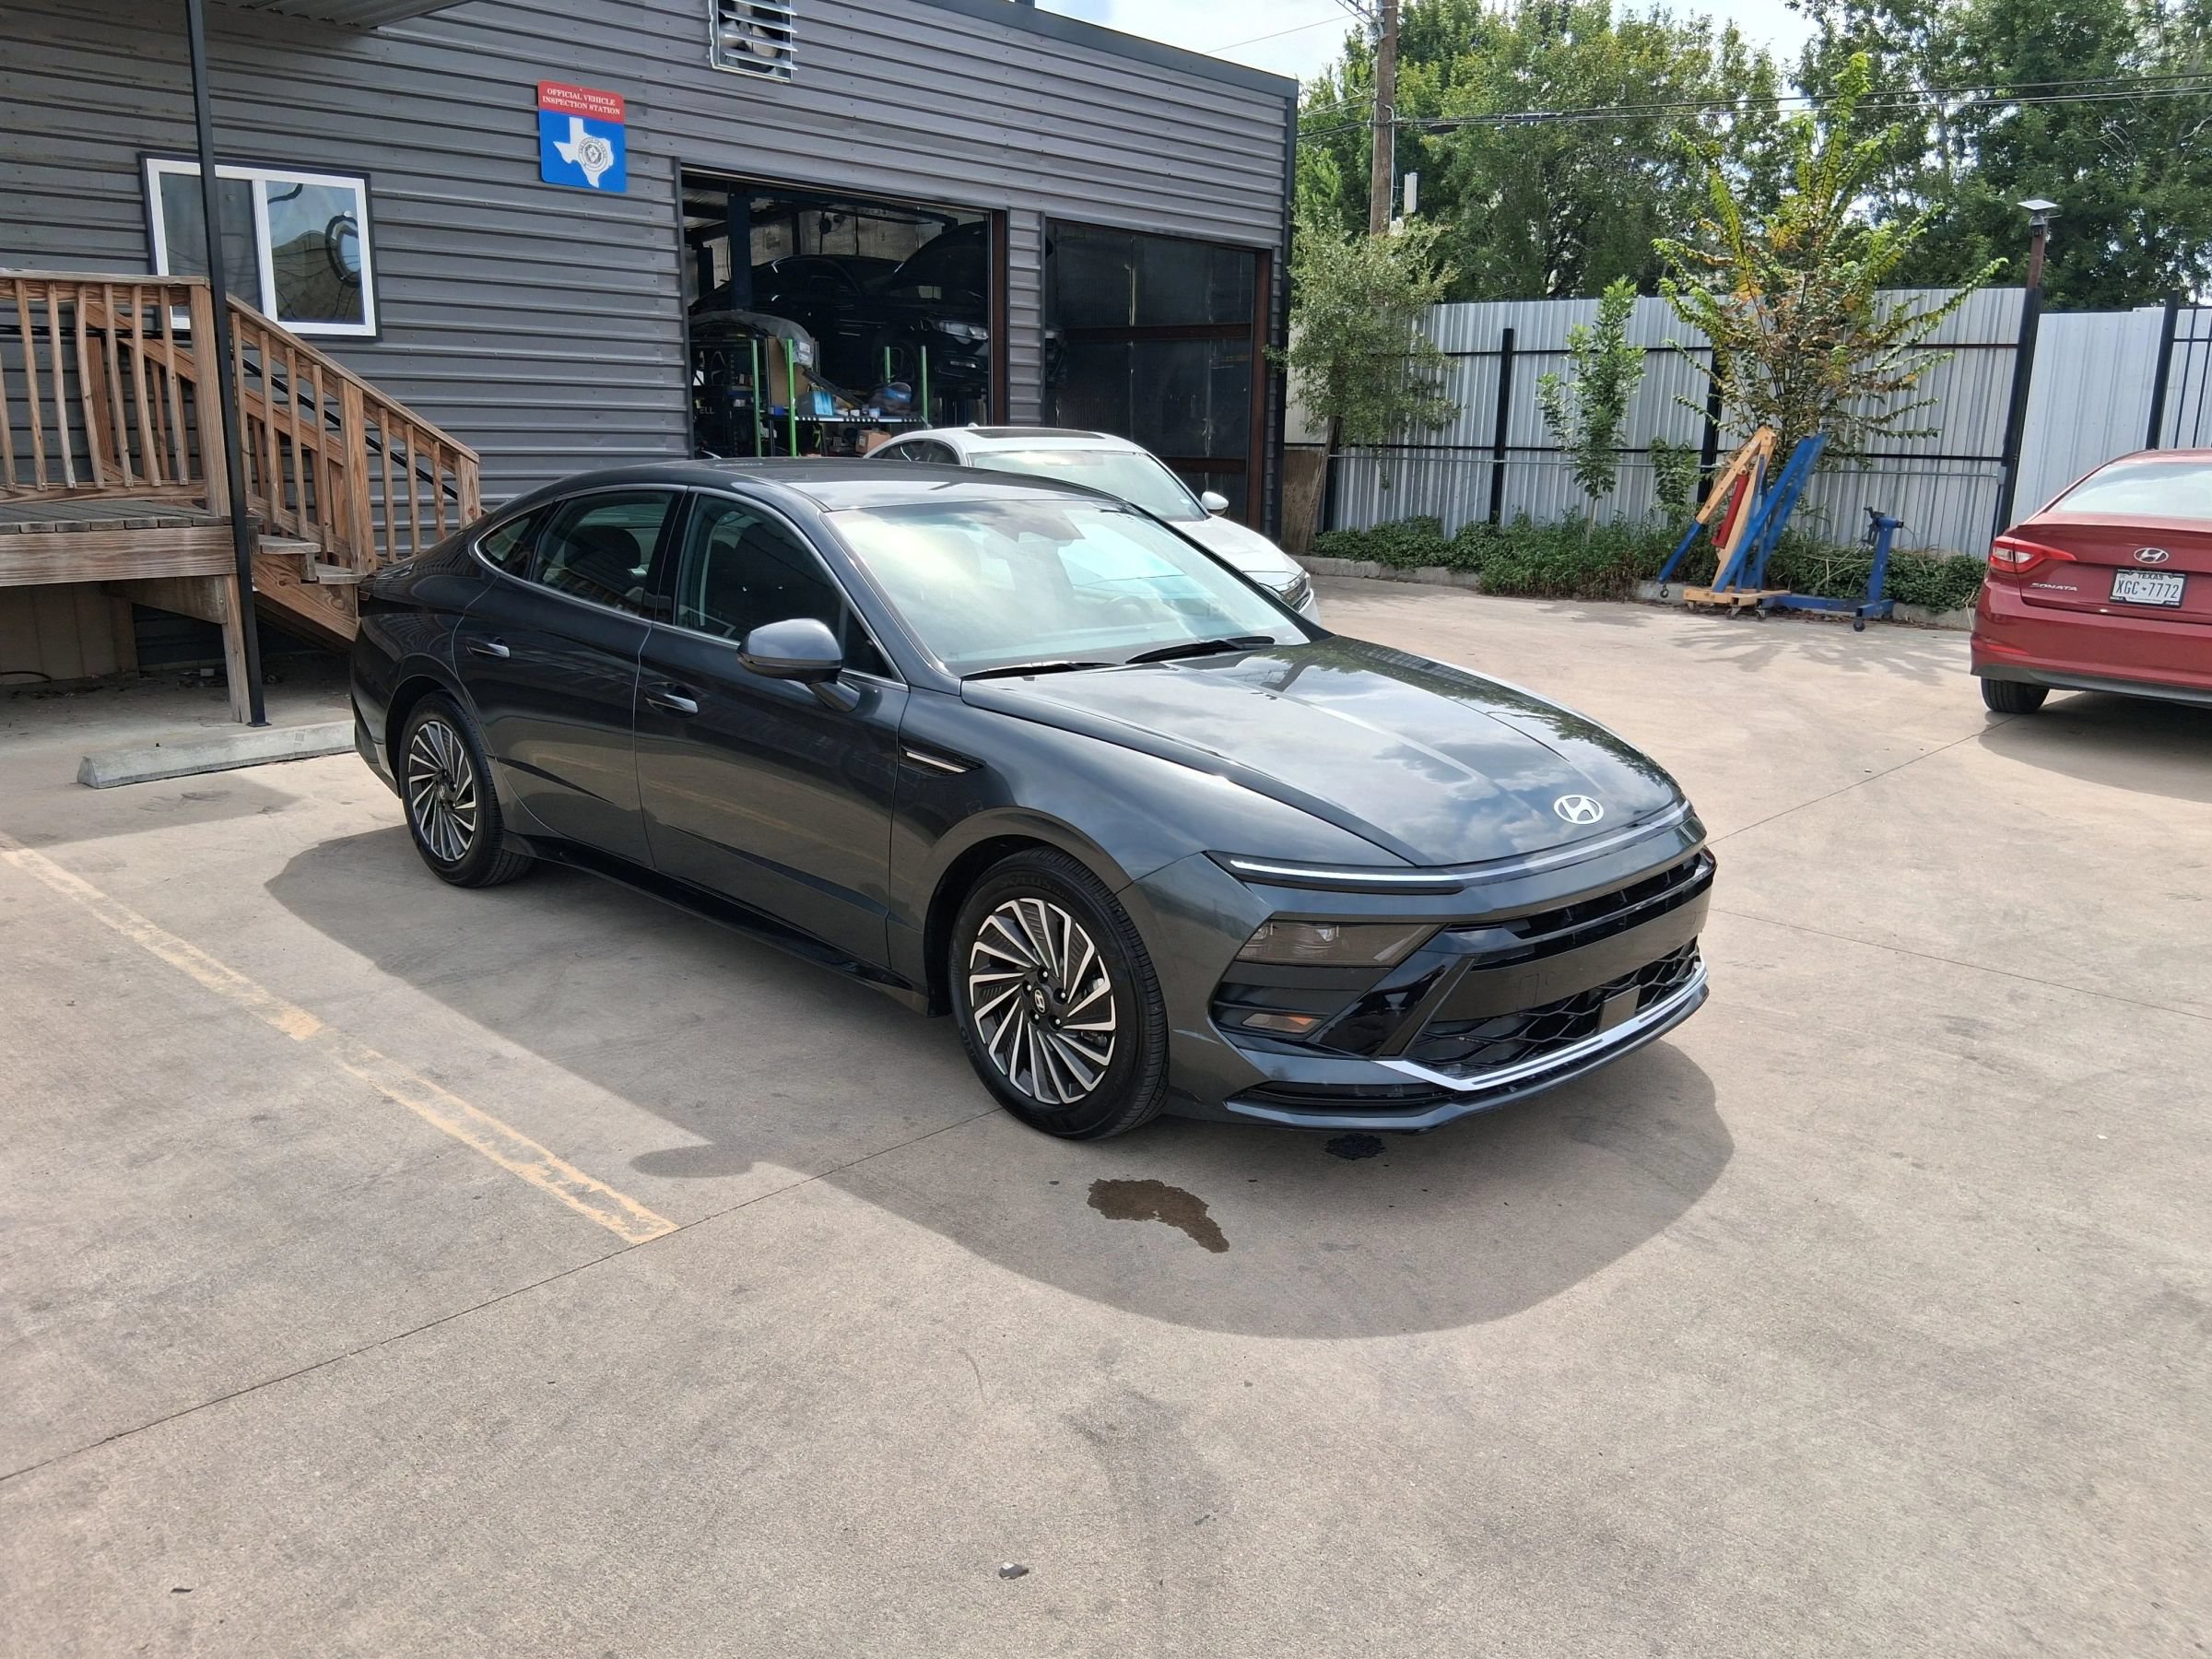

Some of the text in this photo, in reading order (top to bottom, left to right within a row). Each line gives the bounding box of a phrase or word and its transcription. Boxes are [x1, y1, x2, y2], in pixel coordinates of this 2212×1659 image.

[542, 96, 620, 115] INSPECTION STATION
[547, 88, 616, 106] OFFICIAL VEHICLE
[2137, 572, 2164, 581] TEXAS
[2030, 582, 2078, 592] SONATA
[2116, 580, 2179, 599] XGC 7772
